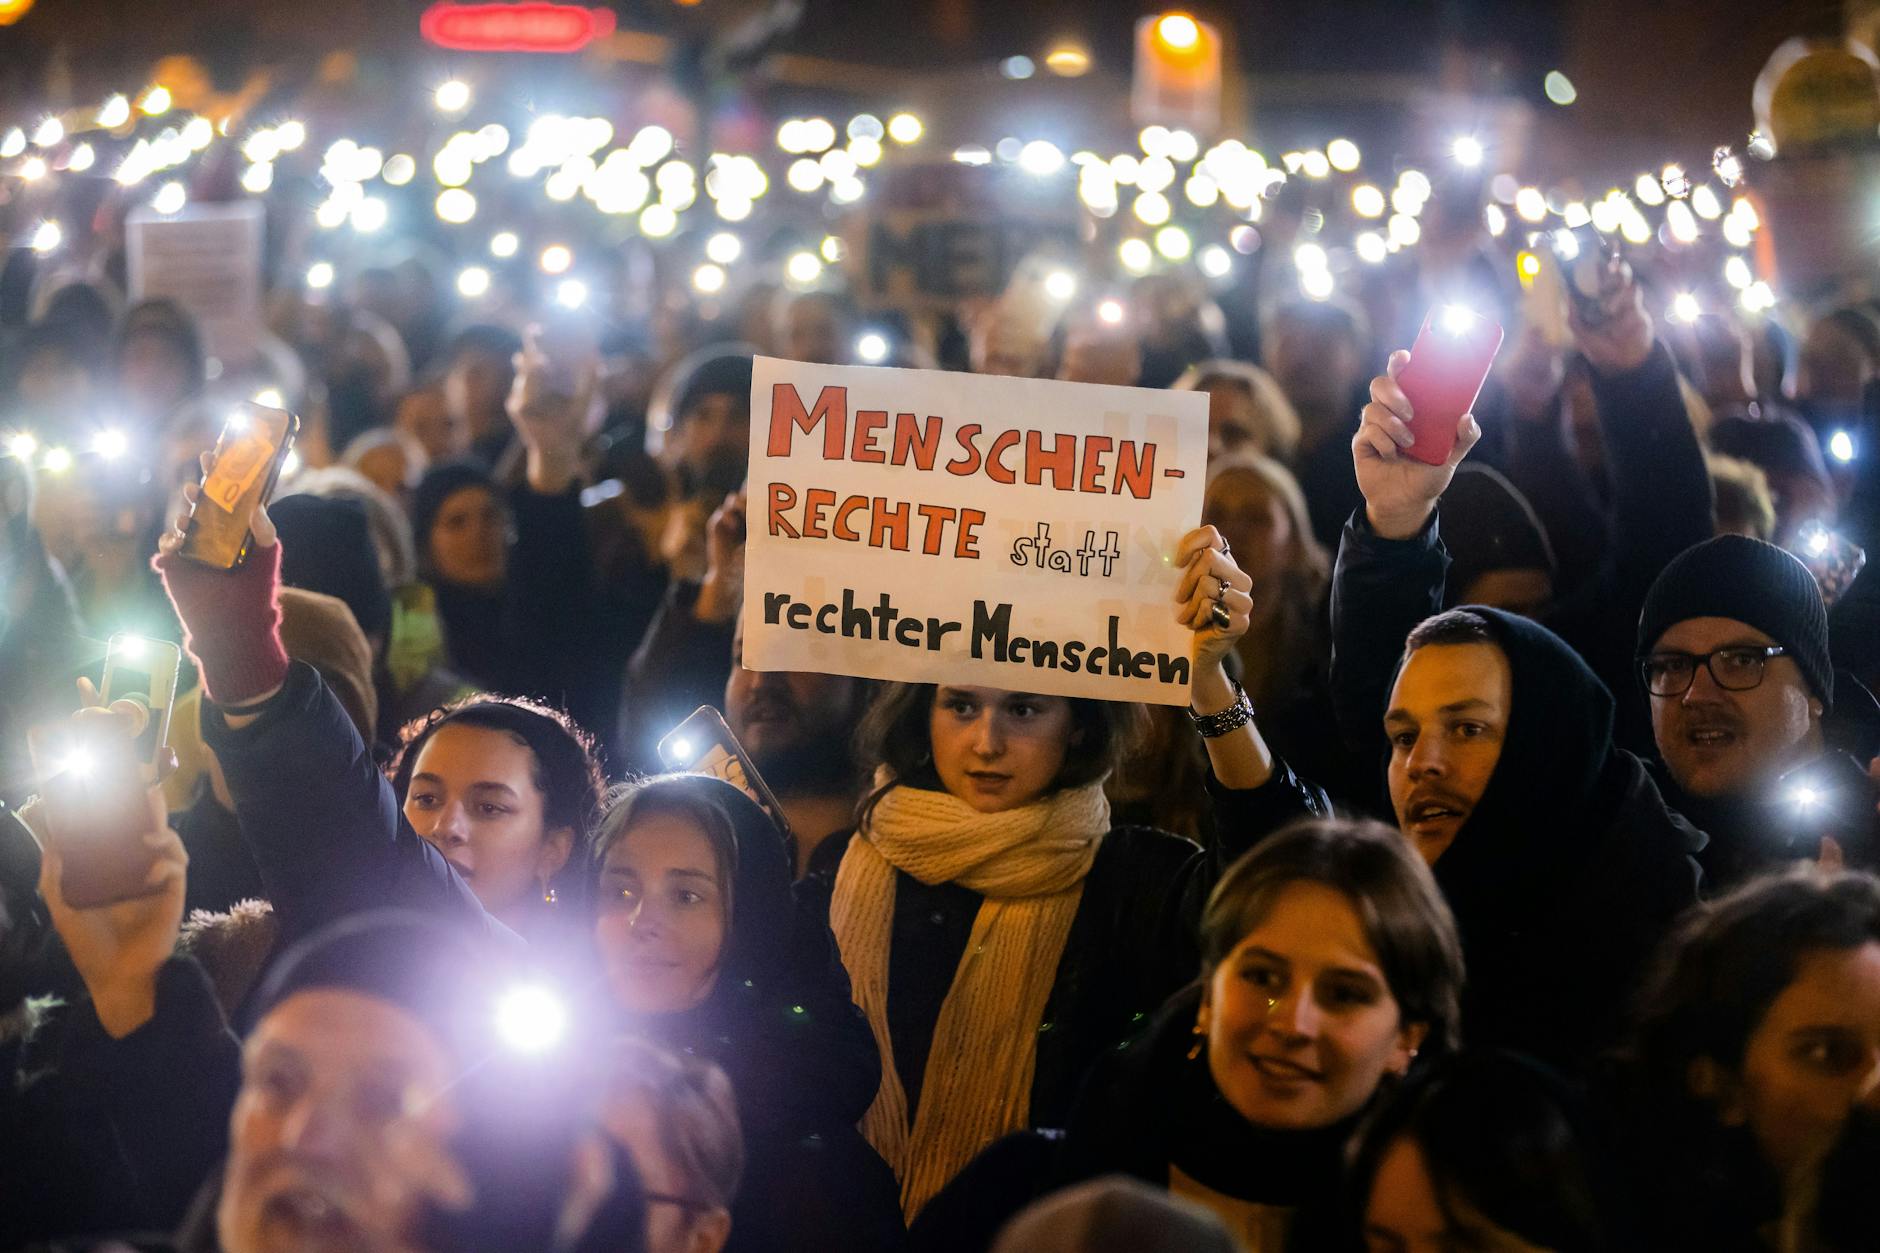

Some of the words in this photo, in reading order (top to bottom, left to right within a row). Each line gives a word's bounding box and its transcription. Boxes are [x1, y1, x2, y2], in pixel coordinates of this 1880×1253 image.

[767, 384, 1185, 499] MENSCHEN-
[768, 482, 986, 559] RECHTE
[1010, 522, 1120, 578] statt
[764, 589, 961, 652] rechter
[971, 601, 1190, 684] Menschen
